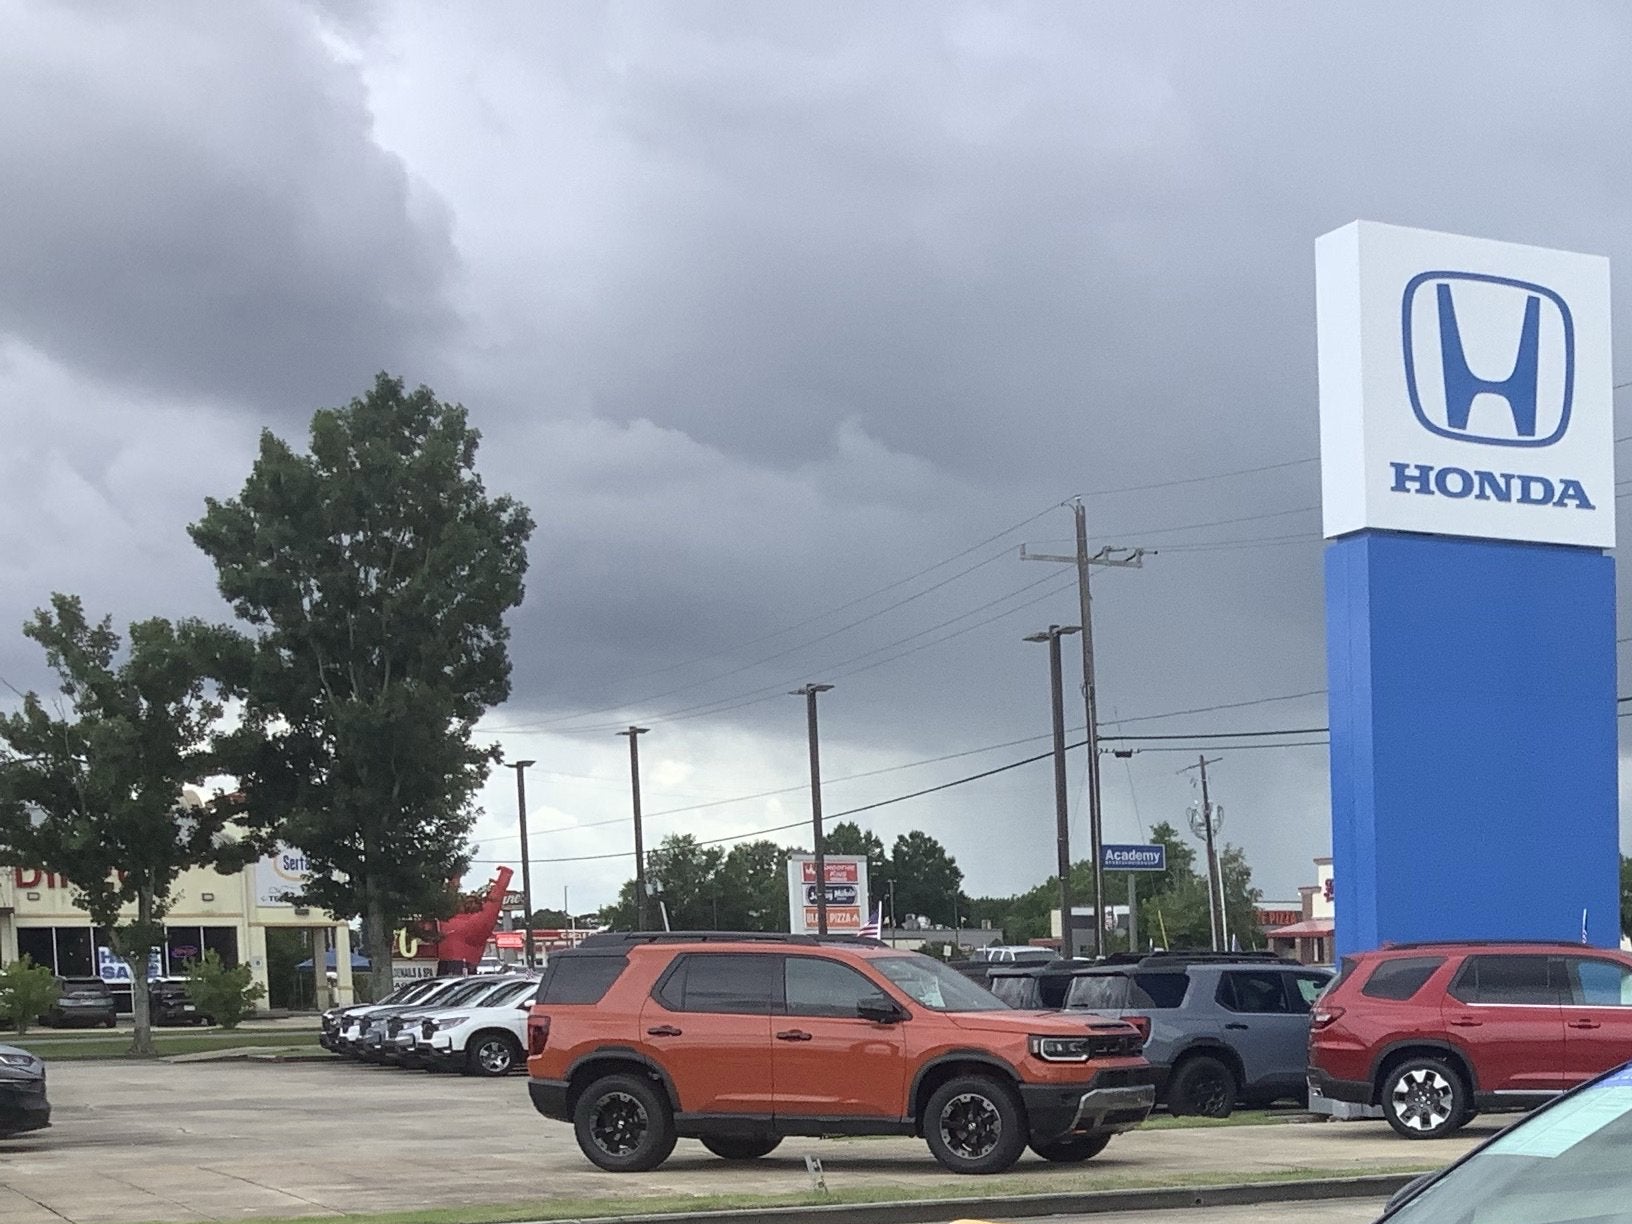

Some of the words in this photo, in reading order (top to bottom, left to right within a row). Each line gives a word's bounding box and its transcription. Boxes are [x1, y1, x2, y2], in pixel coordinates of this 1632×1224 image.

[1389, 461, 1596, 510] HONDA
[1104, 848, 1161, 864] Academy
[829, 912, 851, 924] PIZZA
[1269, 911, 1298, 925] PIZZA
